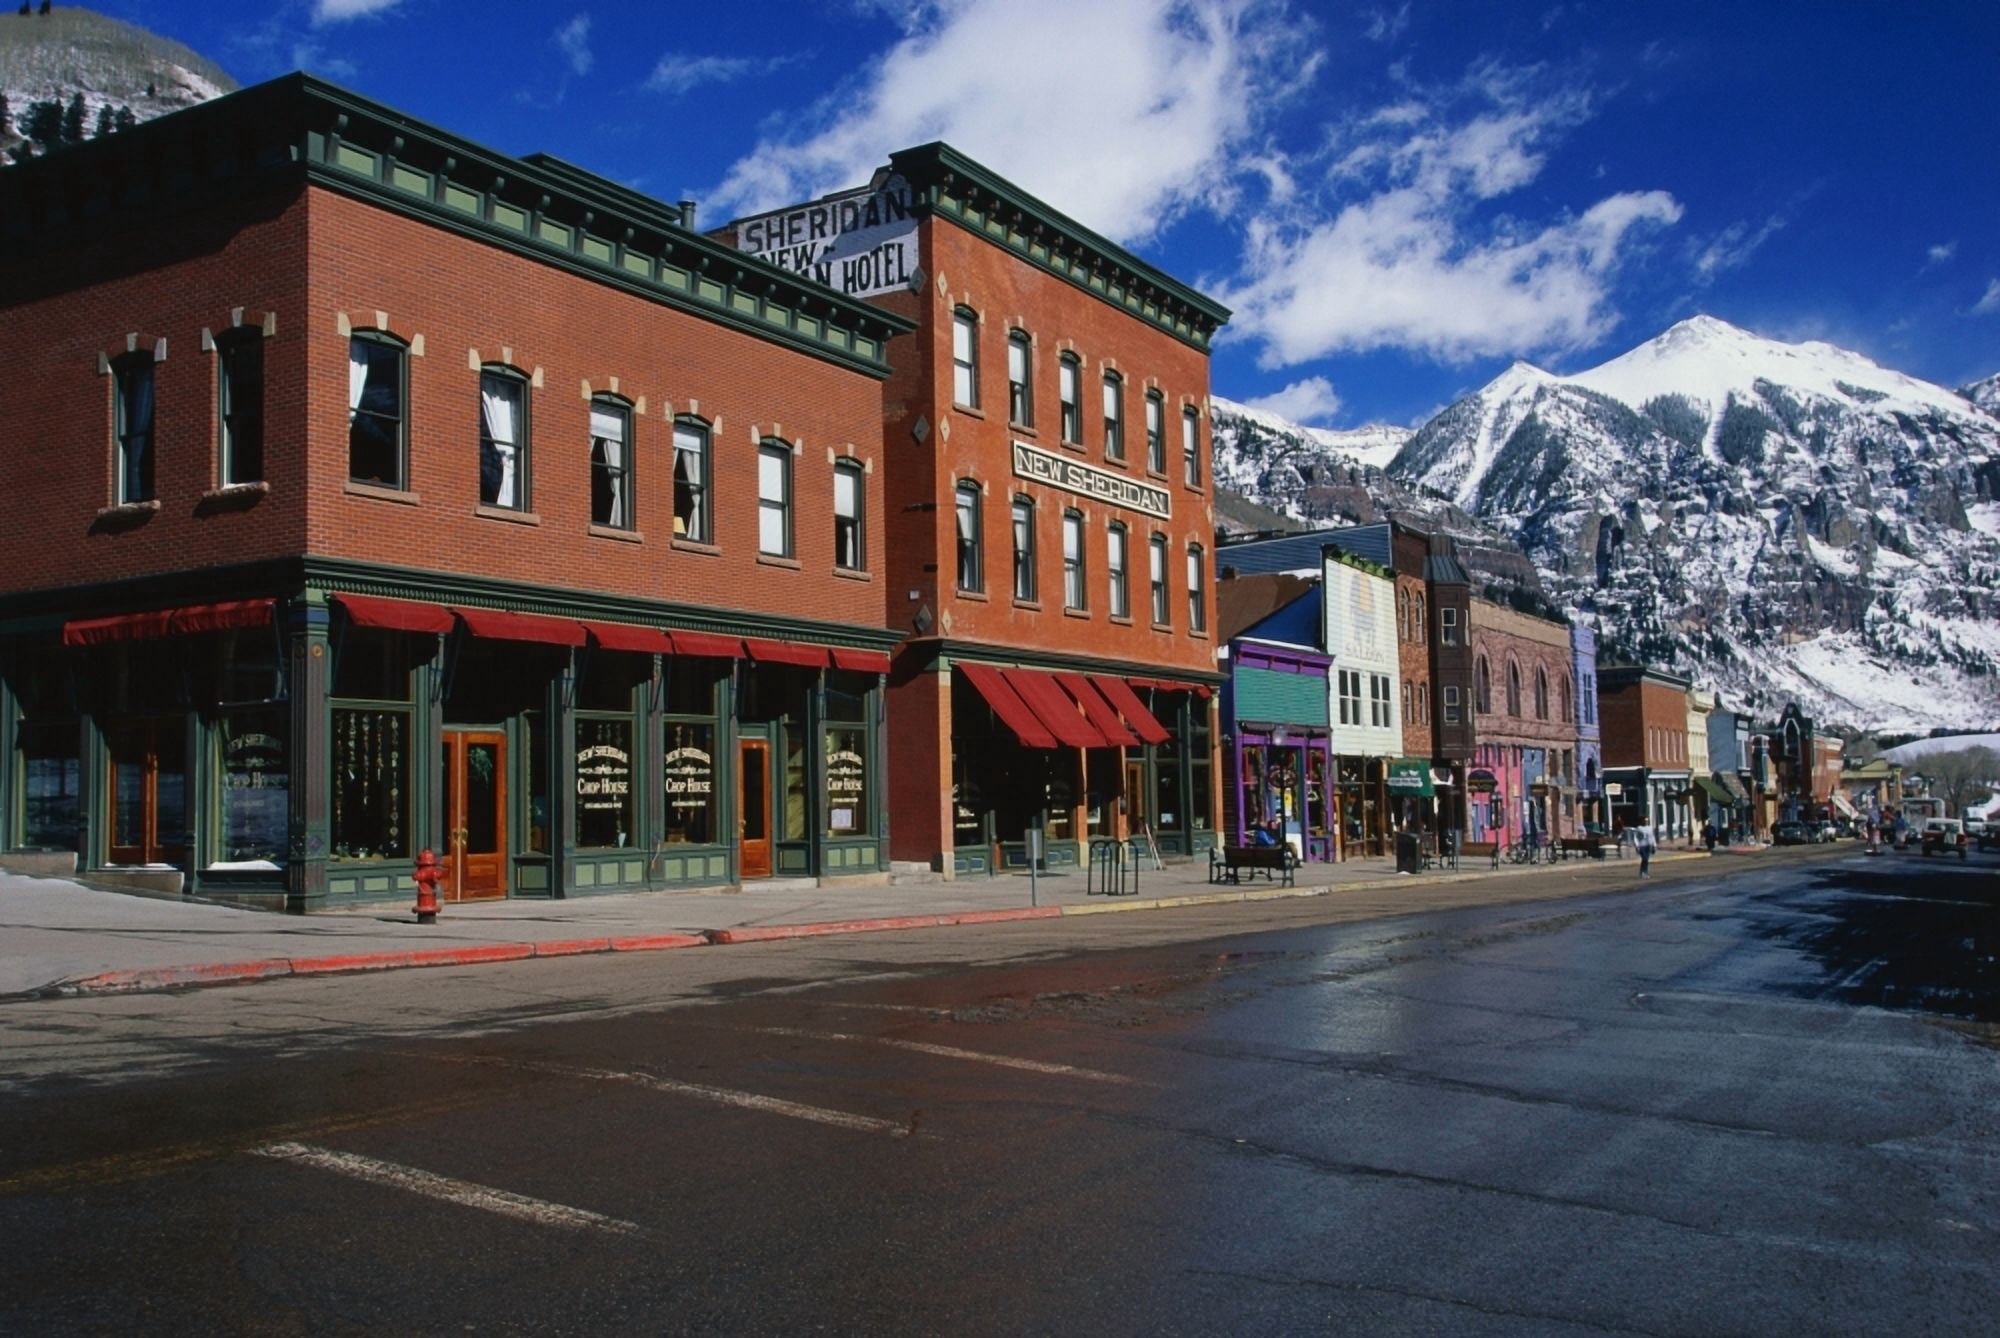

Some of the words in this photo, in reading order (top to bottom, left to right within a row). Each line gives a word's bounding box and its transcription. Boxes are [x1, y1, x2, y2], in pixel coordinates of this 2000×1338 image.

[745, 189, 905, 252] SHERIDAN
[843, 243, 910, 294] HOTEL
[1017, 448, 1062, 481] NEW
[1067, 465, 1167, 513] SHERIDAN
[601, 778, 628, 794] HOUSE
